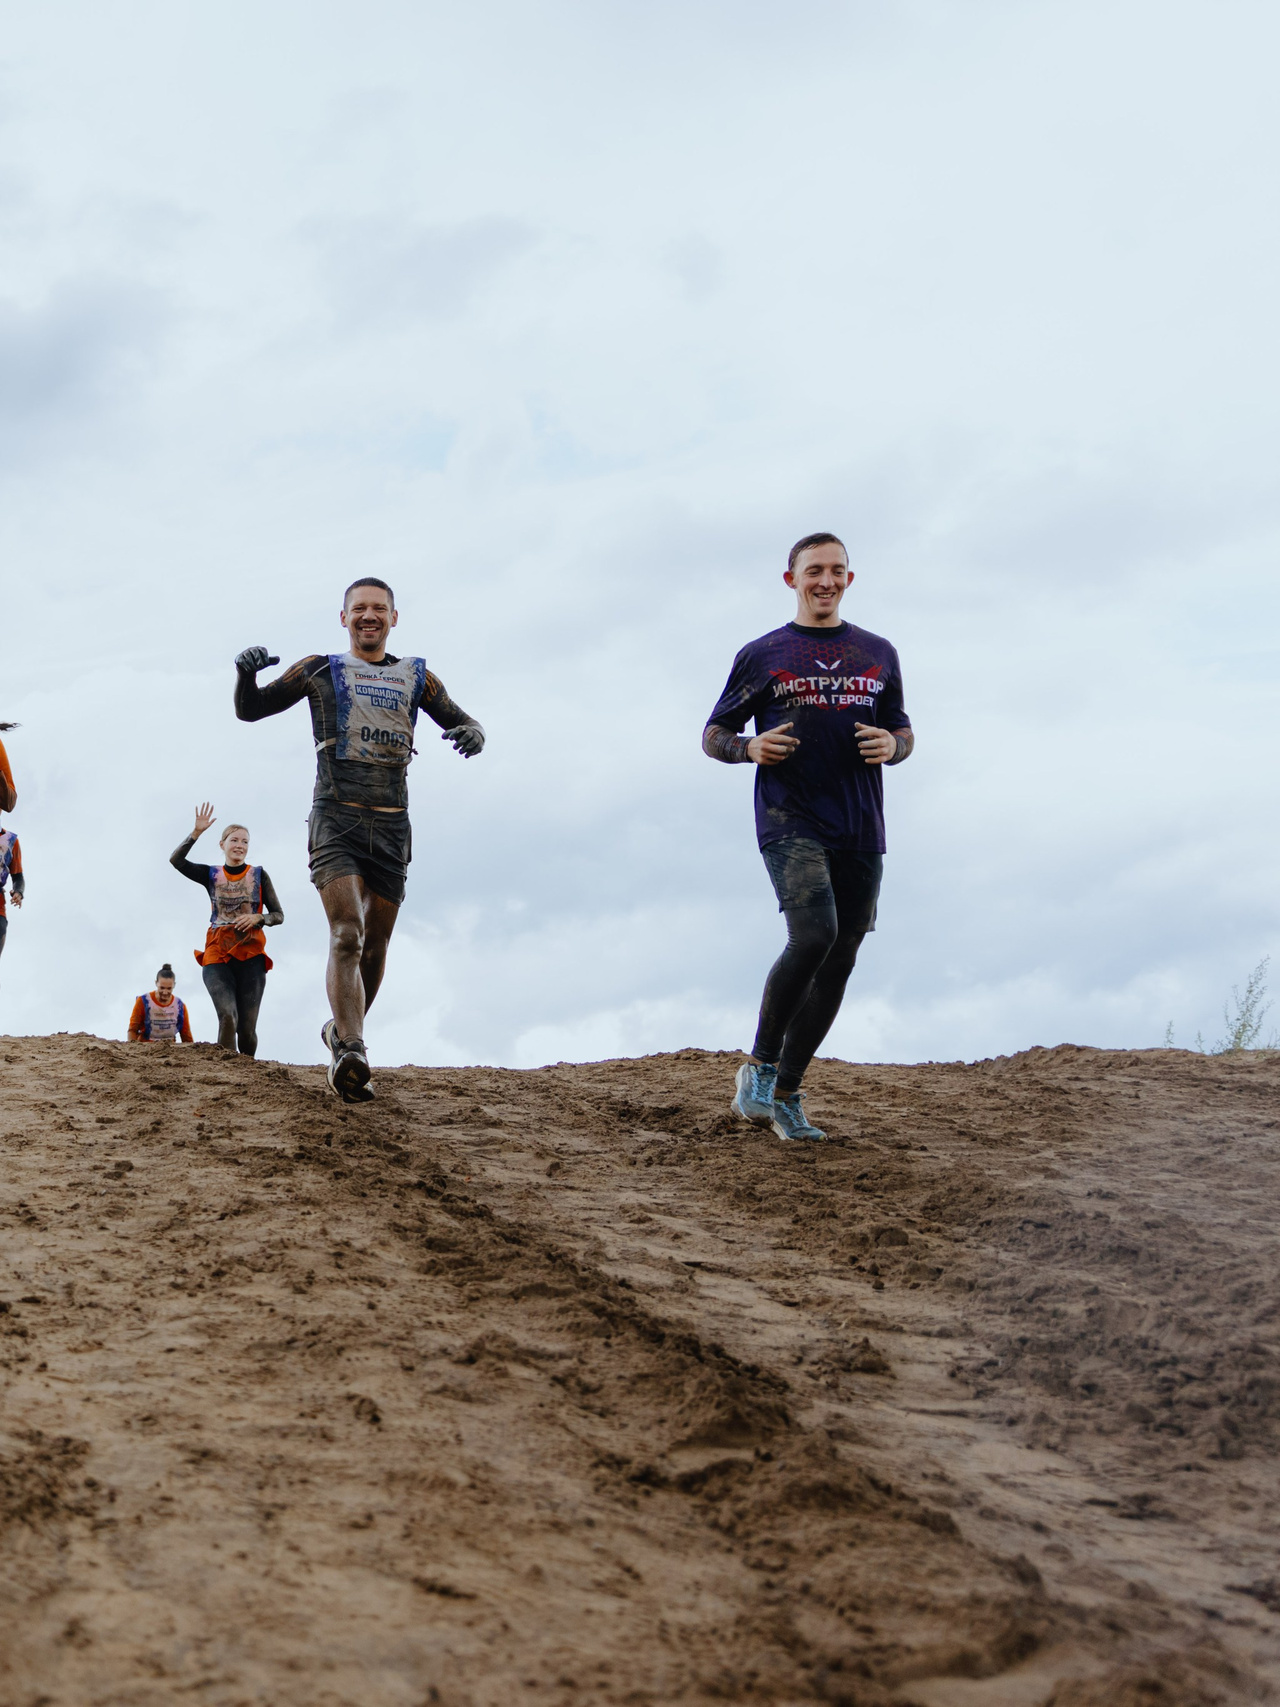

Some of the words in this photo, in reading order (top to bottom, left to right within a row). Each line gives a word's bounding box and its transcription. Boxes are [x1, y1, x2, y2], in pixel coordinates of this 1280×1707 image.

[773, 677, 884, 698] ИНСТРУКТОР
[372, 696, 397, 710] СТАРТ
[786, 694, 828, 708] ГОНКА
